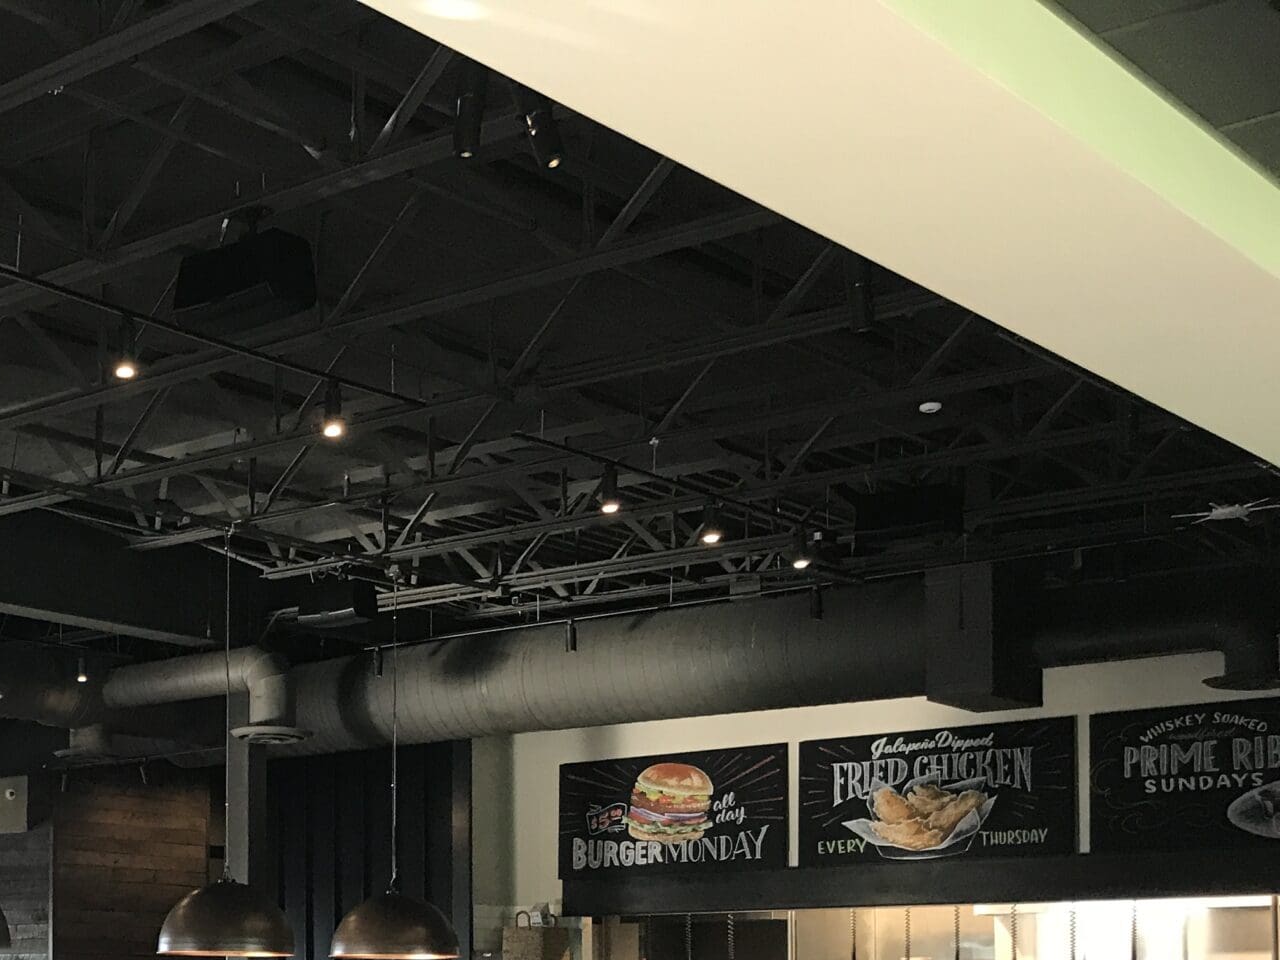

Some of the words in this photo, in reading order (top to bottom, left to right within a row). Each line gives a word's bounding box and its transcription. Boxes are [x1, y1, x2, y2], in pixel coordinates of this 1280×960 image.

[1139, 712, 1206, 743] WHISKEY
[1212, 711, 1268, 732] SOAKED
[870, 736, 935, 760] Jalapeño
[935, 730, 994, 752] Dipped
[1123, 740, 1220, 778] PRIME
[830, 756, 908, 807] FRIED
[913, 746, 1034, 792] CHICKEN
[1144, 772, 1264, 793] SUNDAYS
[713, 791, 736, 811] all
[716, 806, 747, 825] day
[572, 837, 664, 870] BURGER
[665, 824, 770, 864] MONDAY
[817, 838, 869, 855] EVERY
[978, 828, 1048, 846] THURSDAY
